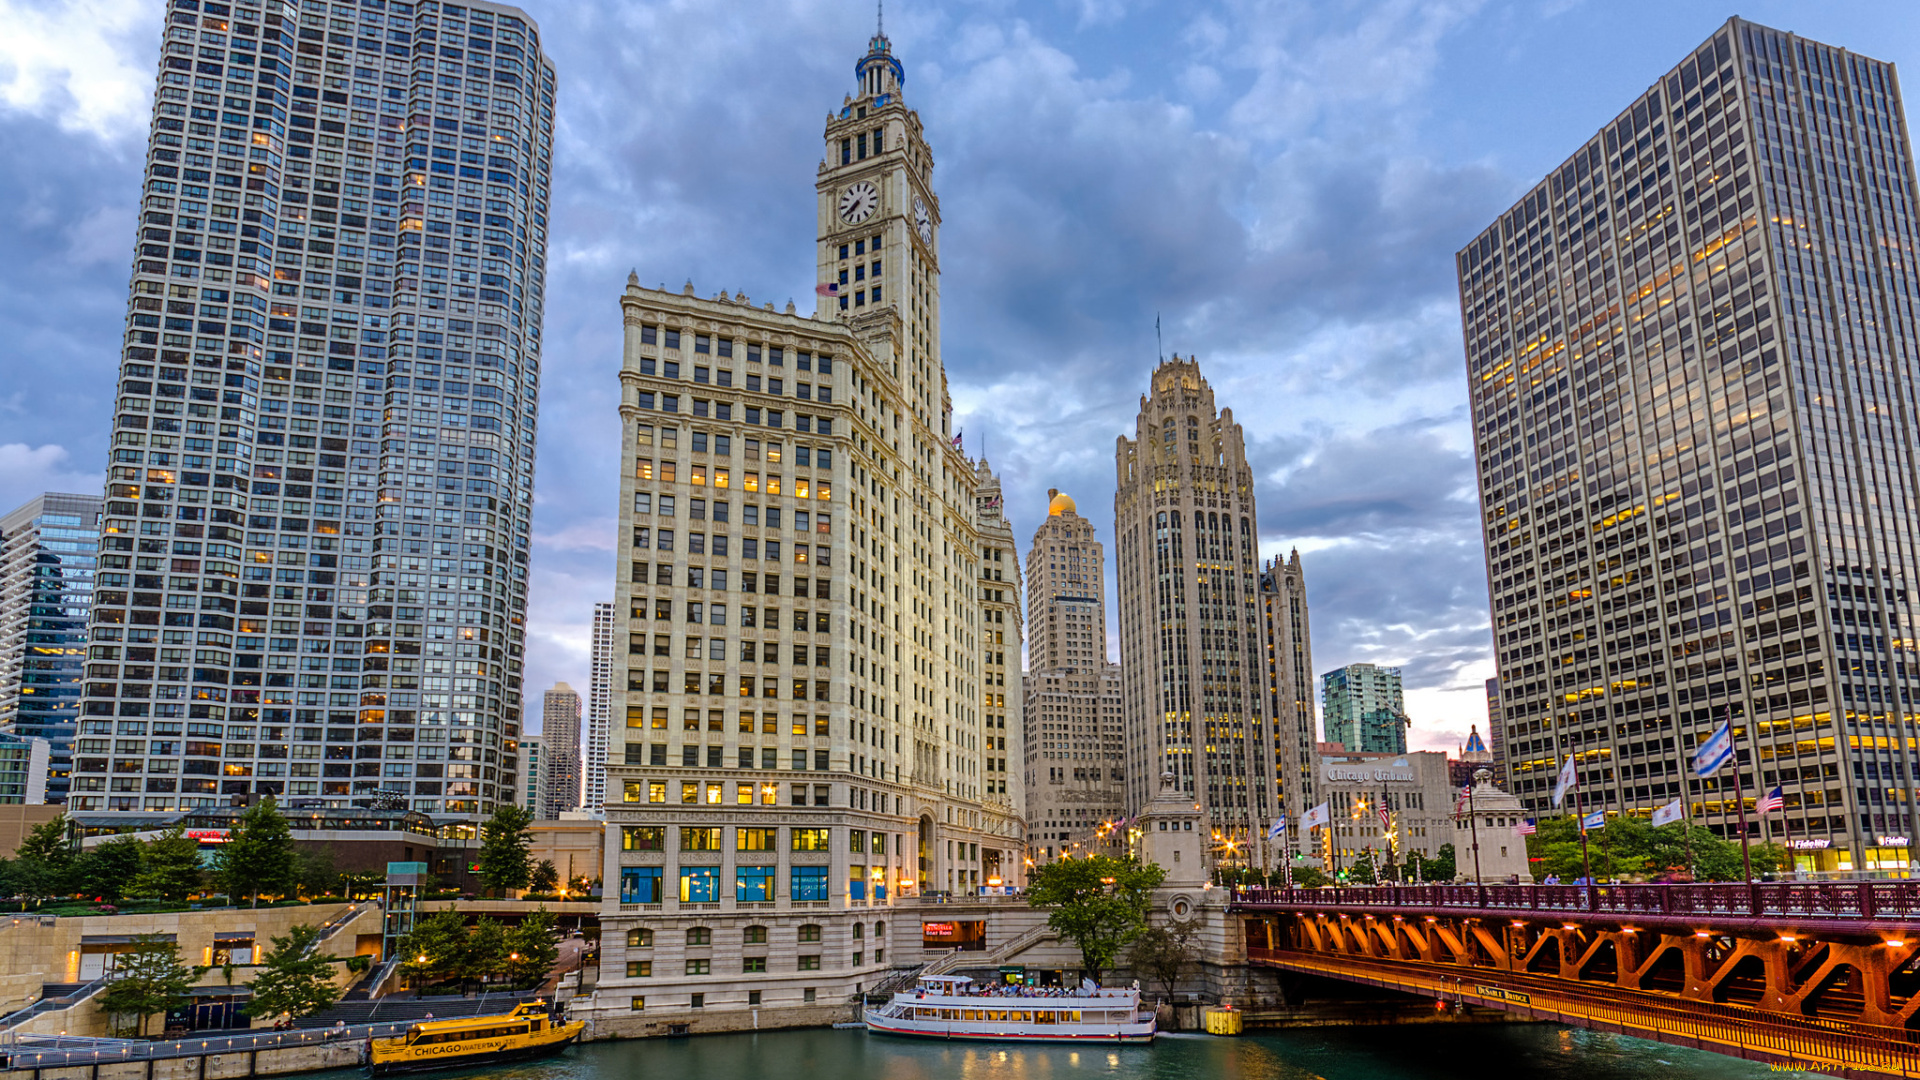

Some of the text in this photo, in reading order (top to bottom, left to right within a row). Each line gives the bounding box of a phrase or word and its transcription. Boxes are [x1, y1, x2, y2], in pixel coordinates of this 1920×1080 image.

[1327, 768, 1414, 783] Chicago Tribune
[1794, 838, 1831, 850] Fidelity
[1884, 836, 1910, 846] Fidelity
[414, 1044, 461, 1057] CHICAGO
